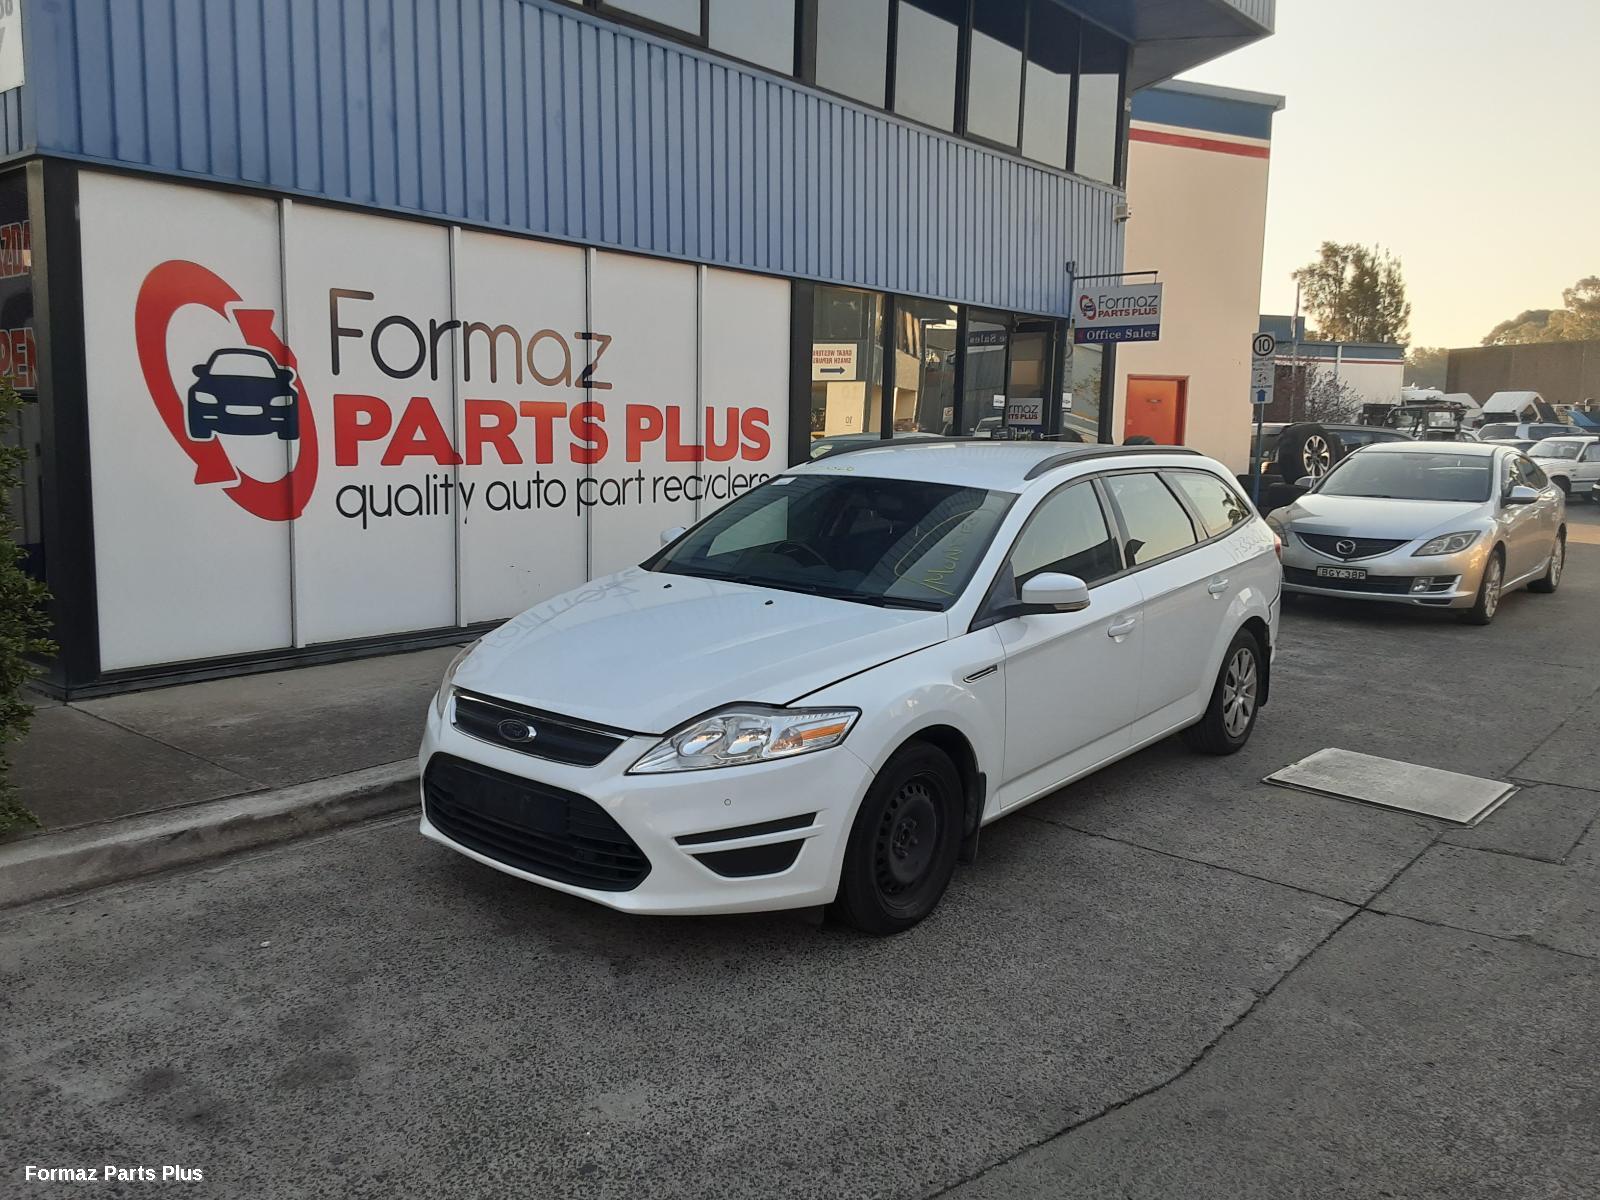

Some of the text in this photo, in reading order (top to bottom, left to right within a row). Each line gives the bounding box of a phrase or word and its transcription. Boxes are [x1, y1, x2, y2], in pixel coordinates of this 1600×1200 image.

[1098, 294, 1159, 309] Formaz
[1098, 307, 1158, 318] PARTS PLUS
[329, 287, 613, 390] Formaz
[1086, 328, 1157, 340] Office Sales
[1258, 338, 1271, 352] 10
[332, 393, 771, 467] PARTS PLUS
[335, 473, 476, 530] quality
[485, 470, 567, 511] auto
[576, 468, 645, 517] part
